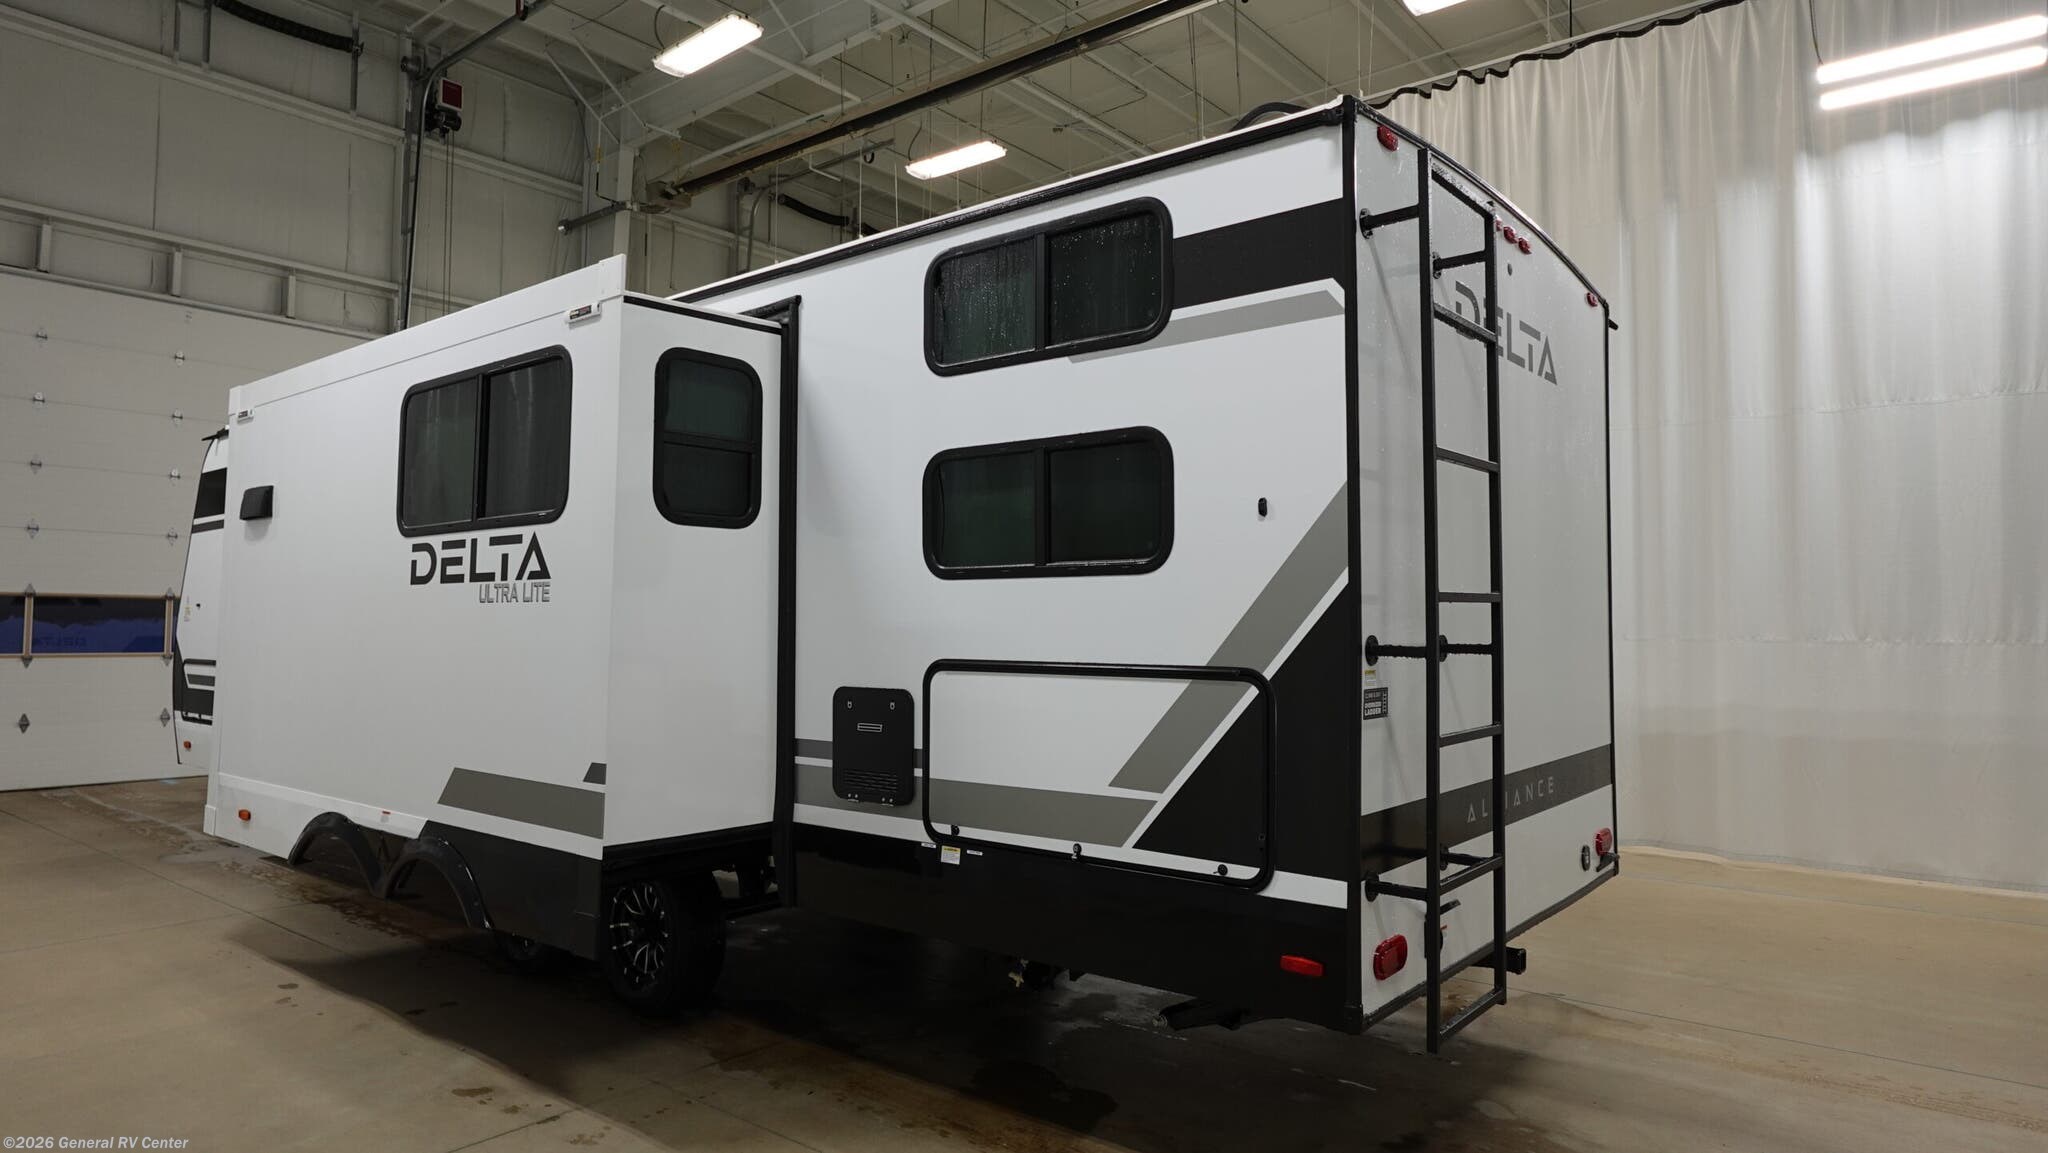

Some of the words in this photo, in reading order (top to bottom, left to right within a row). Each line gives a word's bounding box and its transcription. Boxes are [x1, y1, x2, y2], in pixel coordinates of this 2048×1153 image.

[410, 531, 551, 585] DELTA
[479, 583, 518, 603] ULTRA
[522, 582, 550, 603] LITE
[1467, 776, 1554, 823] ALIANCE
